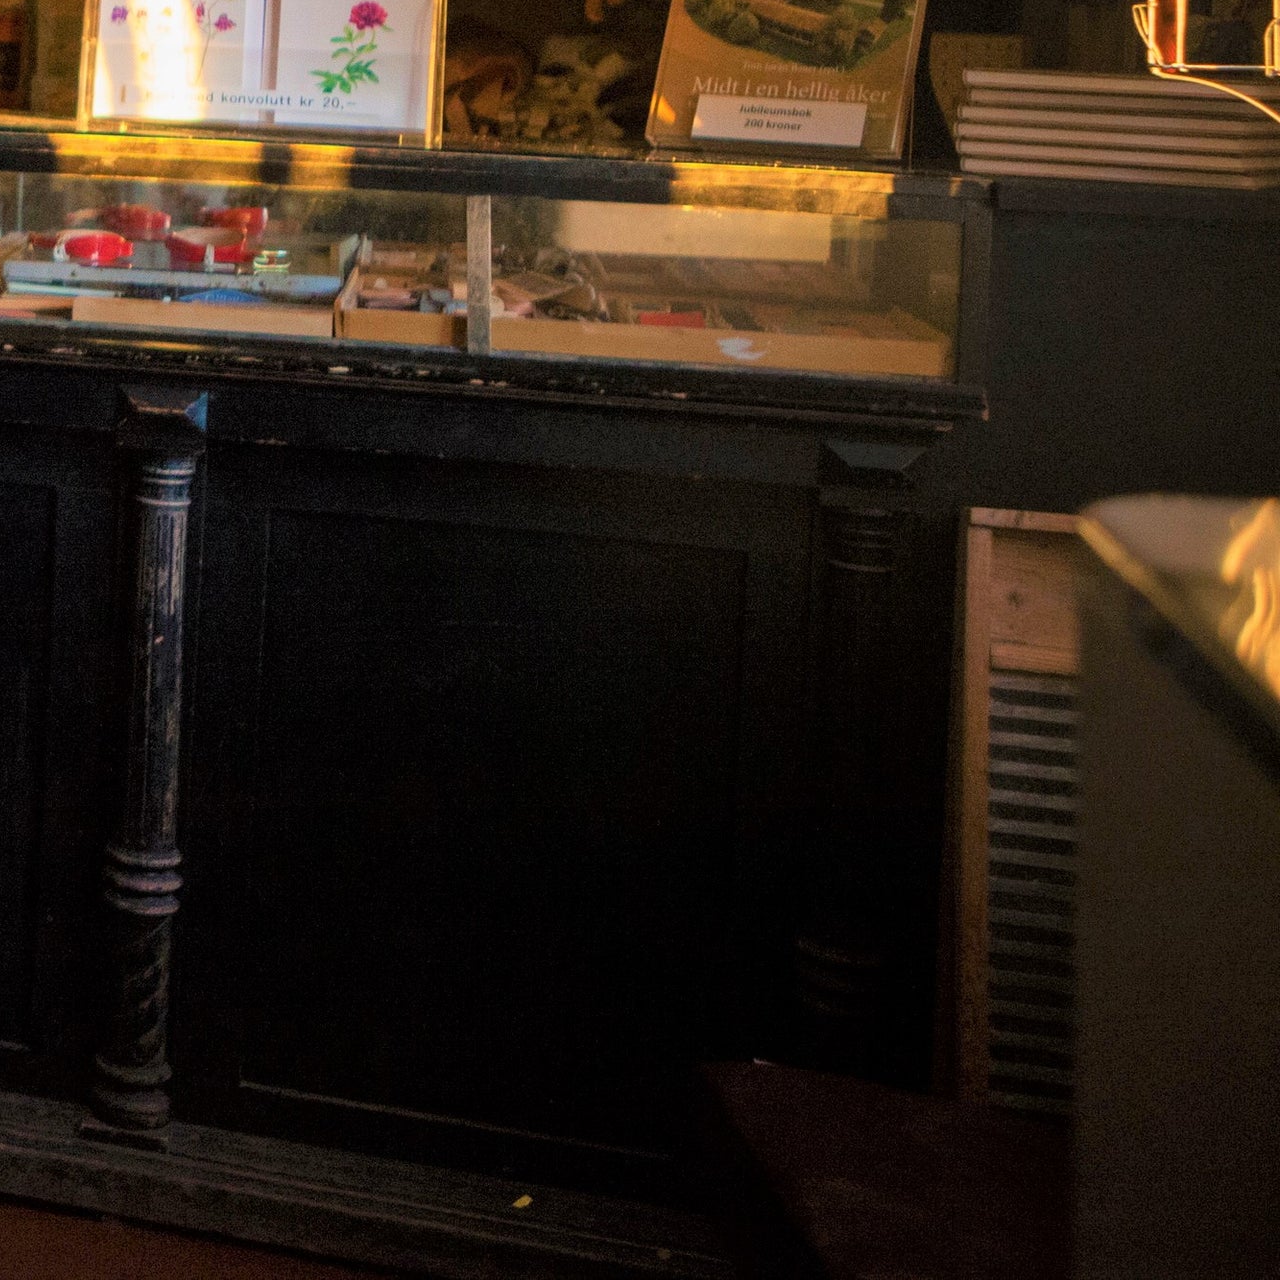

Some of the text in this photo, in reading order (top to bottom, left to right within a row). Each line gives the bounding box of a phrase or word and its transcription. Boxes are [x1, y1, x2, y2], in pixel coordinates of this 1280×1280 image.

[692, 75, 892, 104] Midt i en hellig åker
[220, 91, 292, 107] konvolutt
[299, 95, 315, 108] kr
[739, 103, 813, 118] Jubileumsbok
[743, 118, 803, 131] 200 kroner
